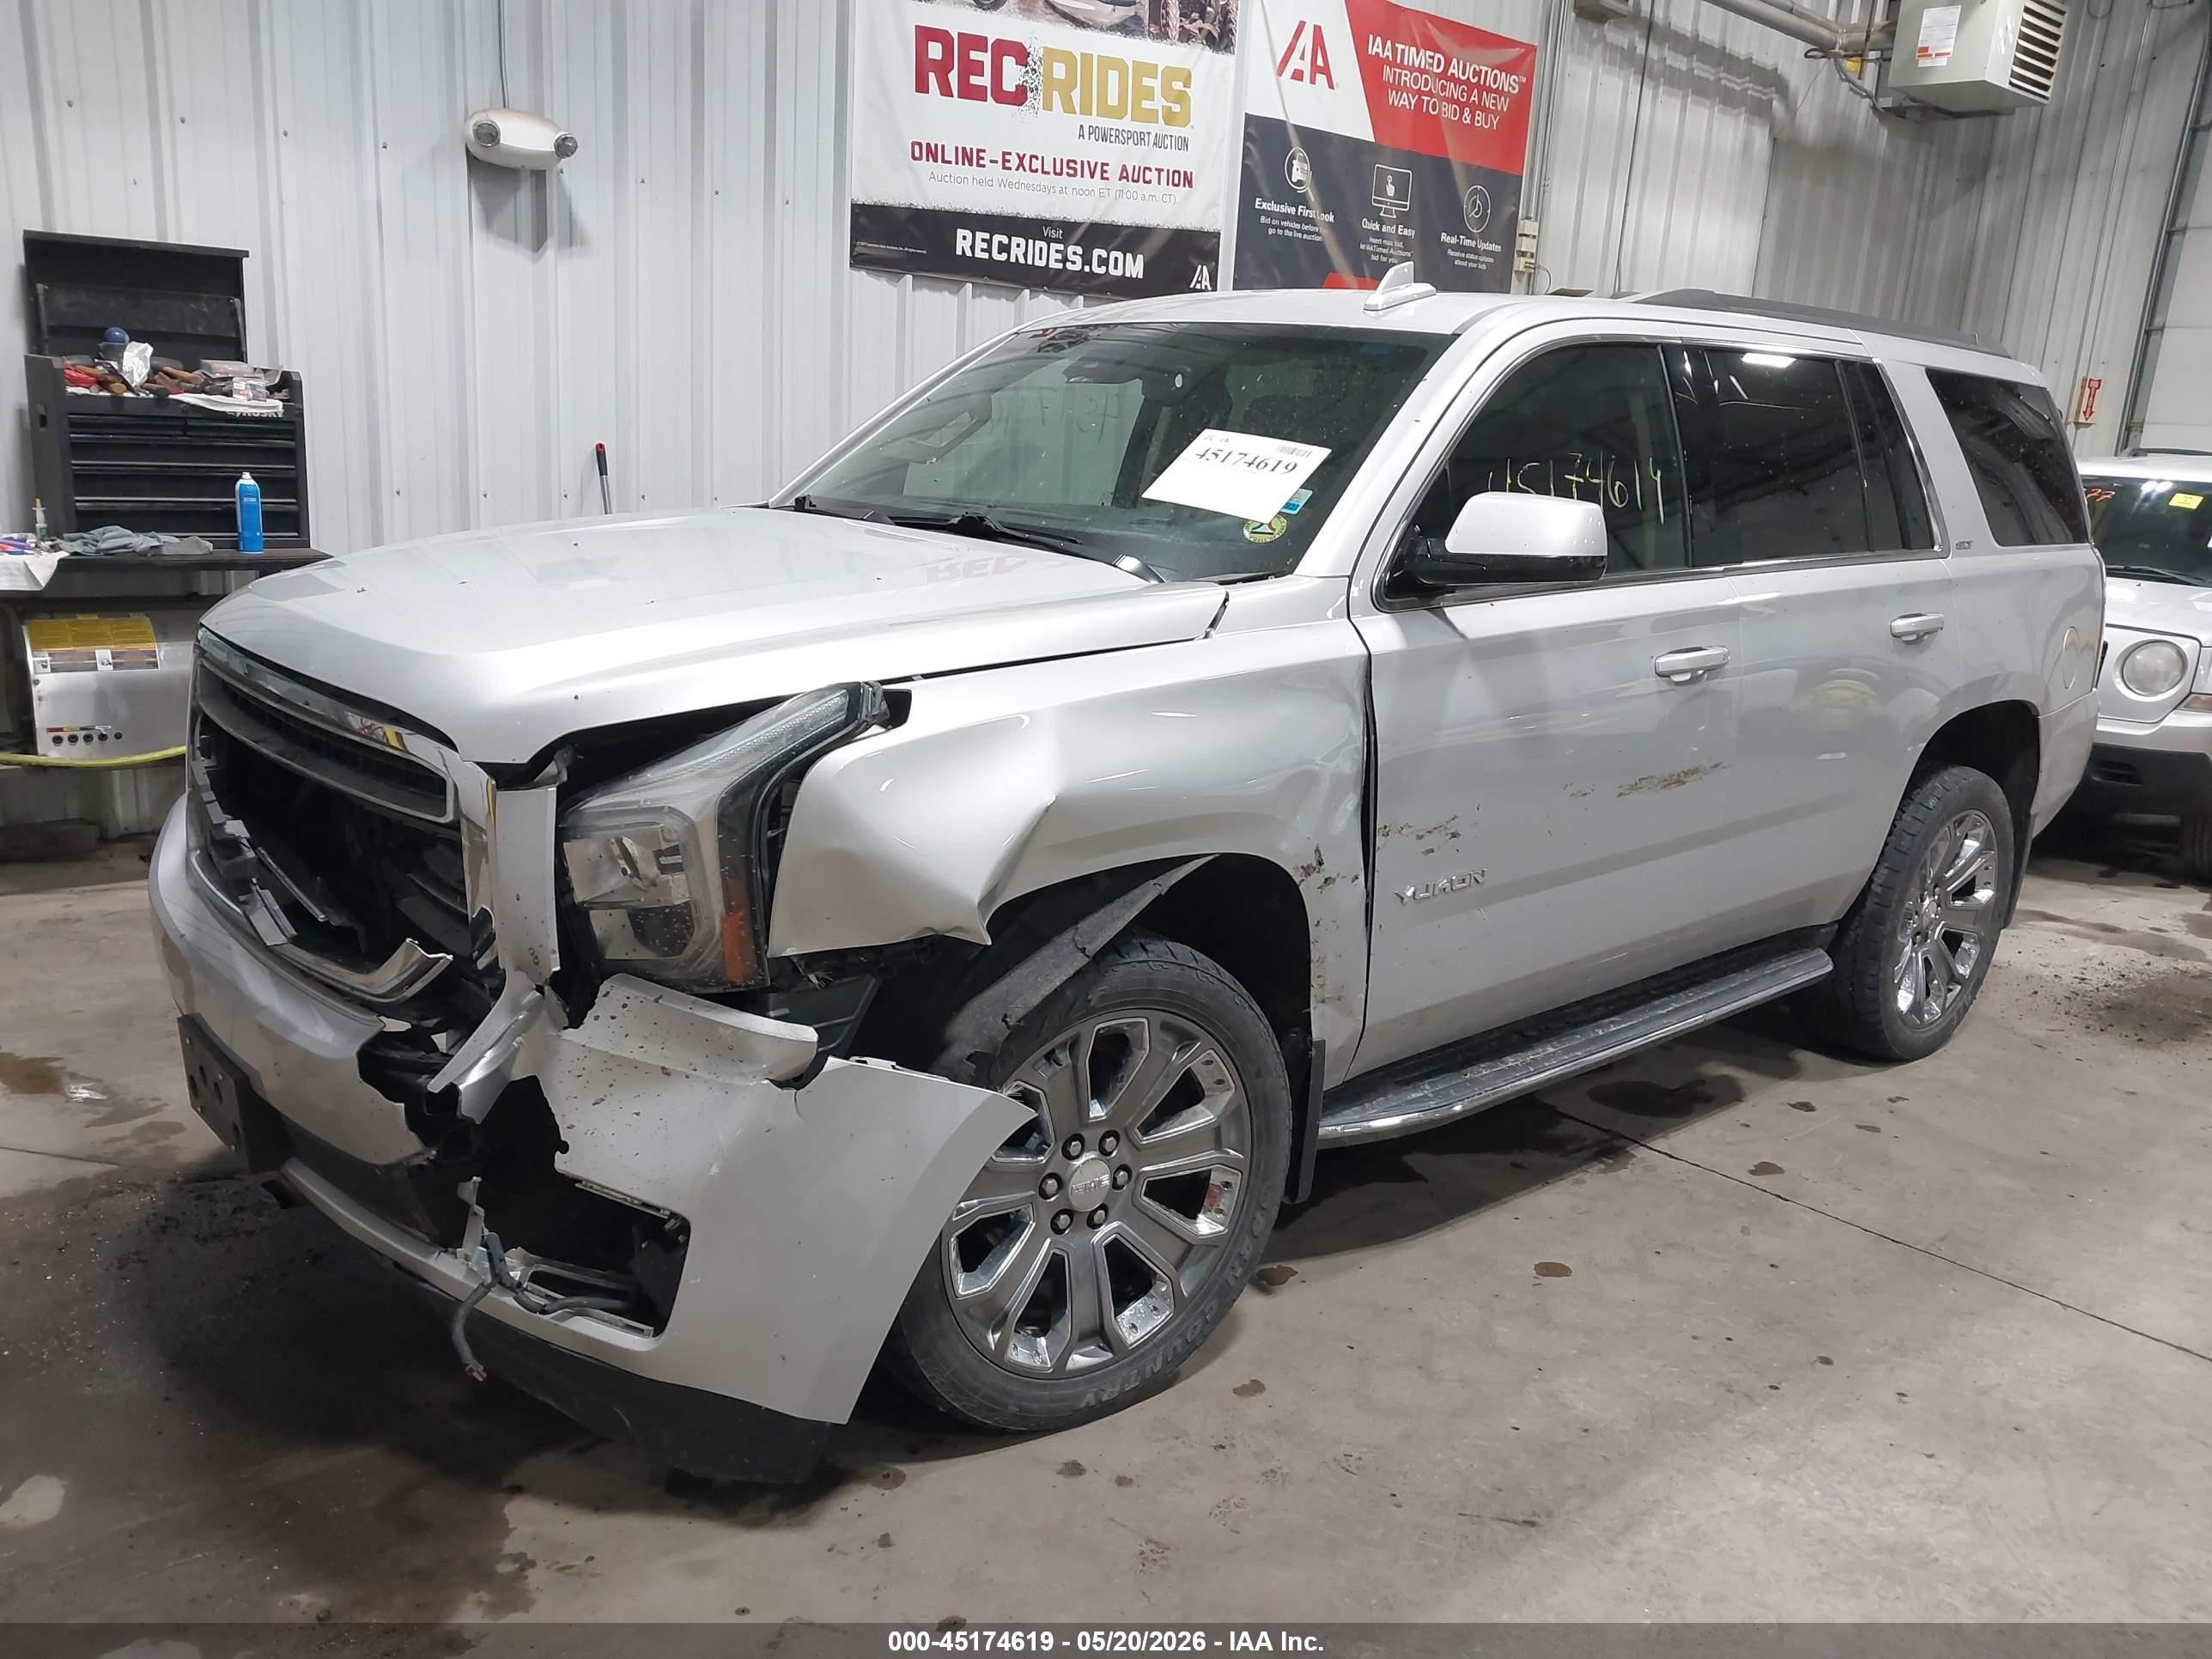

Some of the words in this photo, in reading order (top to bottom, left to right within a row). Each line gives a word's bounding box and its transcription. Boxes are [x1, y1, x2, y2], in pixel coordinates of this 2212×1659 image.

[1368, 33, 1393, 62] IAA
[1395, 42, 1444, 74] TIMED
[1382, 64, 1468, 102] INTRODUCING
[1469, 91, 1479, 105] A
[1481, 93, 1510, 112] NEW
[1388, 88, 1419, 110] WAY
[1421, 95, 1439, 115] TO
[1441, 104, 1459, 121] BID
[1462, 108, 1471, 124] &
[1474, 110, 1499, 131] BUY
[1078, 124, 1085, 140] A
[1088, 125, 1152, 147] POWERSPORT
[1152, 132, 1189, 152] AUCTION
[910, 141, 1110, 181] ONLINE-EXCLUSIVE
[1118, 164, 1194, 189] AUCTION
[929, 172, 969, 185] Auction
[972, 177, 994, 187] held
[997, 179, 1056, 195] Wednesdays
[1058, 185, 1068, 195] at
[1072, 187, 1095, 197] noon
[1098, 188, 1111, 198] ET
[1255, 198, 1297, 215] Exclusive
[1297, 204, 1316, 218] First
[1042, 226, 1063, 240] Visit
[1260, 216, 1271, 224] Bid
[1280, 220, 1301, 230] vehicles
[1301, 224, 1319, 233] before
[1267, 227, 1276, 235] go
[1361, 217, 1381, 232] Quick
[1382, 224, 1396, 234] and
[1398, 224, 1416, 240] Easy
[956, 228, 1144, 280] RECRIDES.COM
[1440, 232, 1477, 248] Real-Time
[1477, 239, 1502, 252] Updates
[1195, 447, 1298, 475] 45174619
[1394, 867, 1488, 904] YUKON
